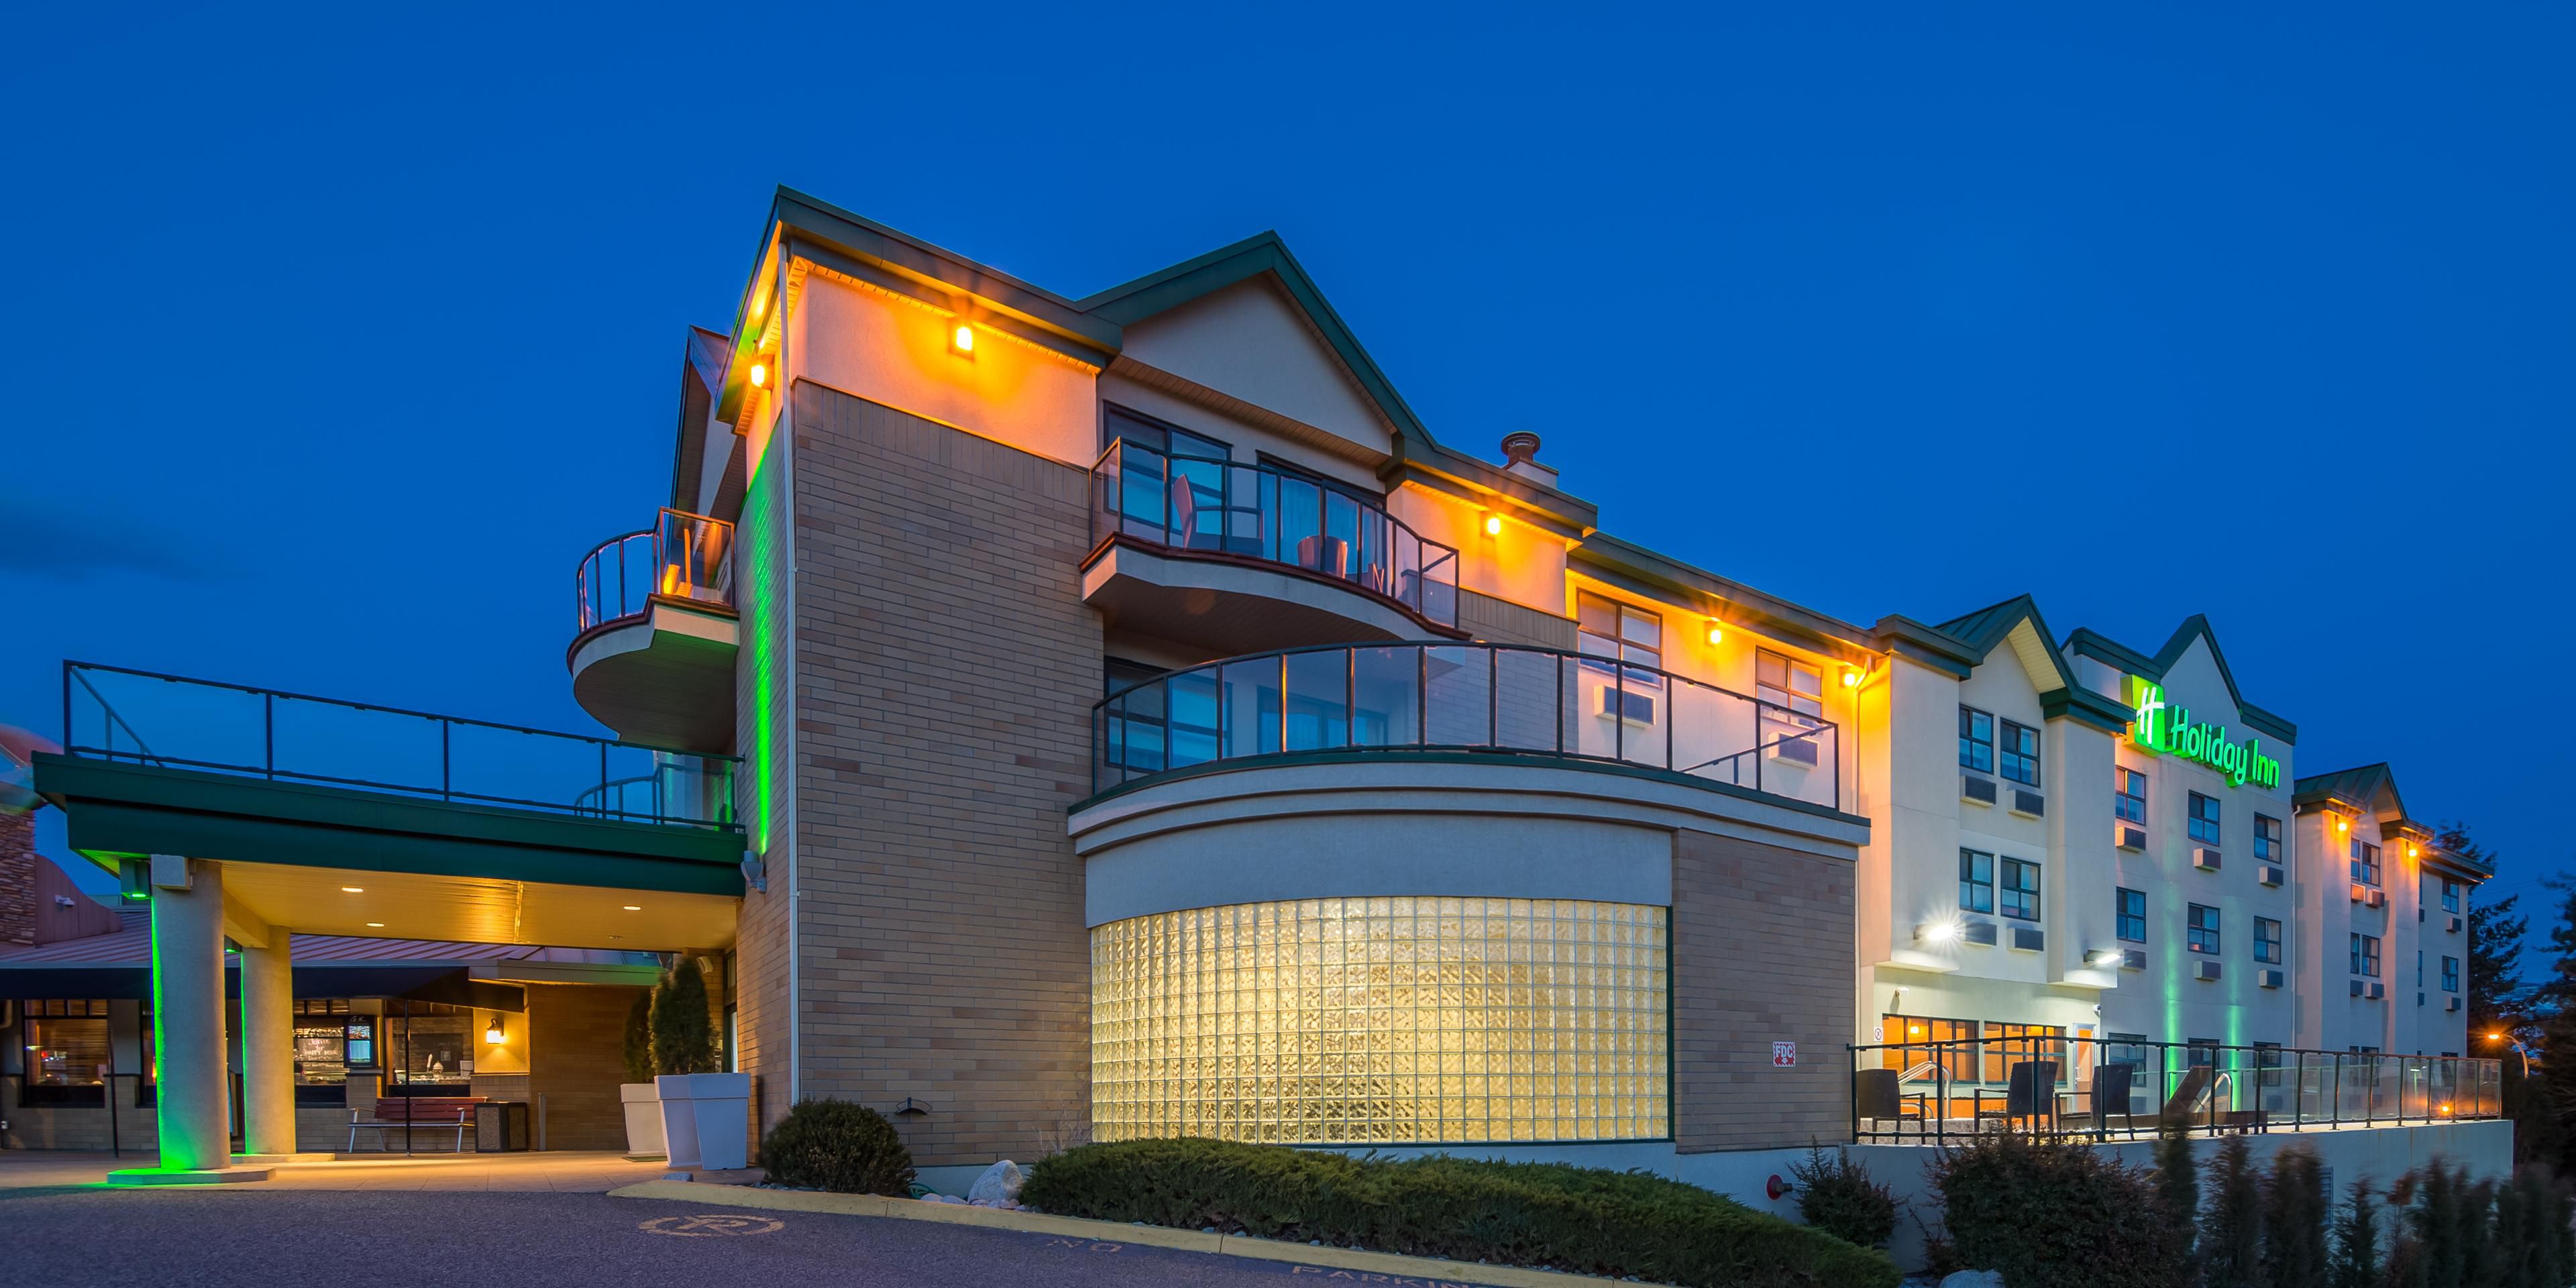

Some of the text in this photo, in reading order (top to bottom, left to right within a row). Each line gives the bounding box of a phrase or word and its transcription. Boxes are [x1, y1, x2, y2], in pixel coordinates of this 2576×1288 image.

[2171, 704, 2279, 788] Holiday Inn
[1776, 1045, 1793, 1058] FDC
[1046, 1238, 1485, 1288] NO PARKIN
